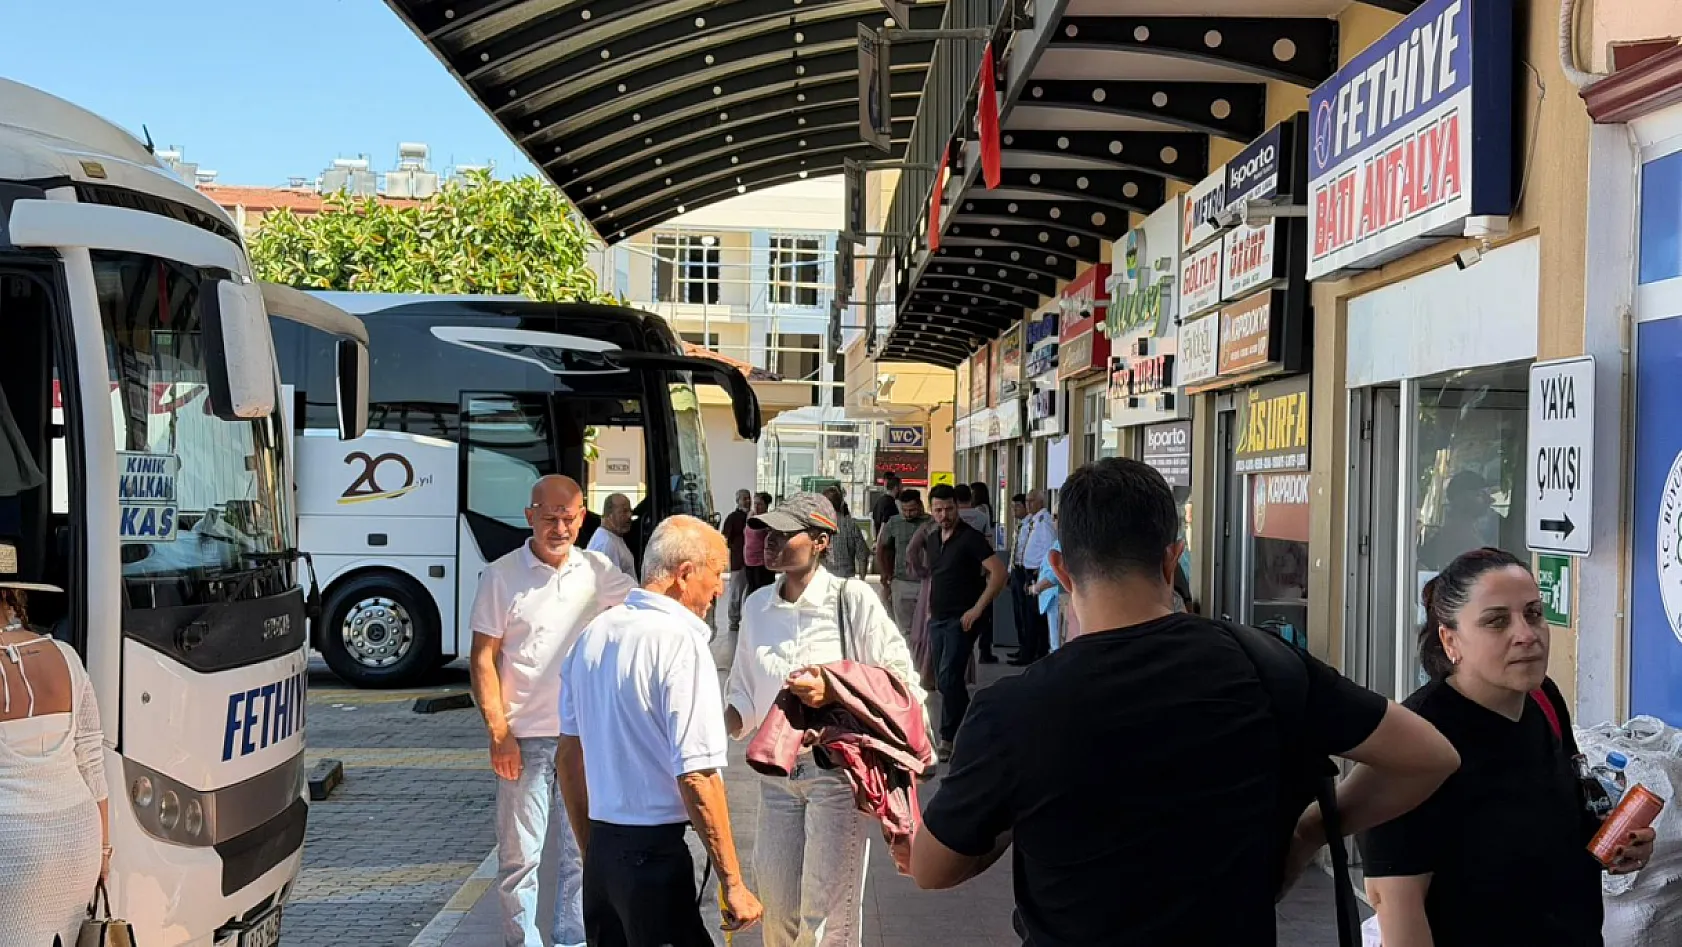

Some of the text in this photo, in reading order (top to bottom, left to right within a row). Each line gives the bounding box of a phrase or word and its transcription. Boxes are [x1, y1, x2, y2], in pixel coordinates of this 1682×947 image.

[1194, 182, 1226, 231] METRO
[1313, 166, 1357, 261] BATI
[1358, 107, 1462, 243] ANTALYA
[1540, 374, 1577, 421] YAYA
[890, 429, 913, 444] WC
[126, 457, 166, 473] KINIK
[1537, 446, 1581, 502] ÇIKIŞI
